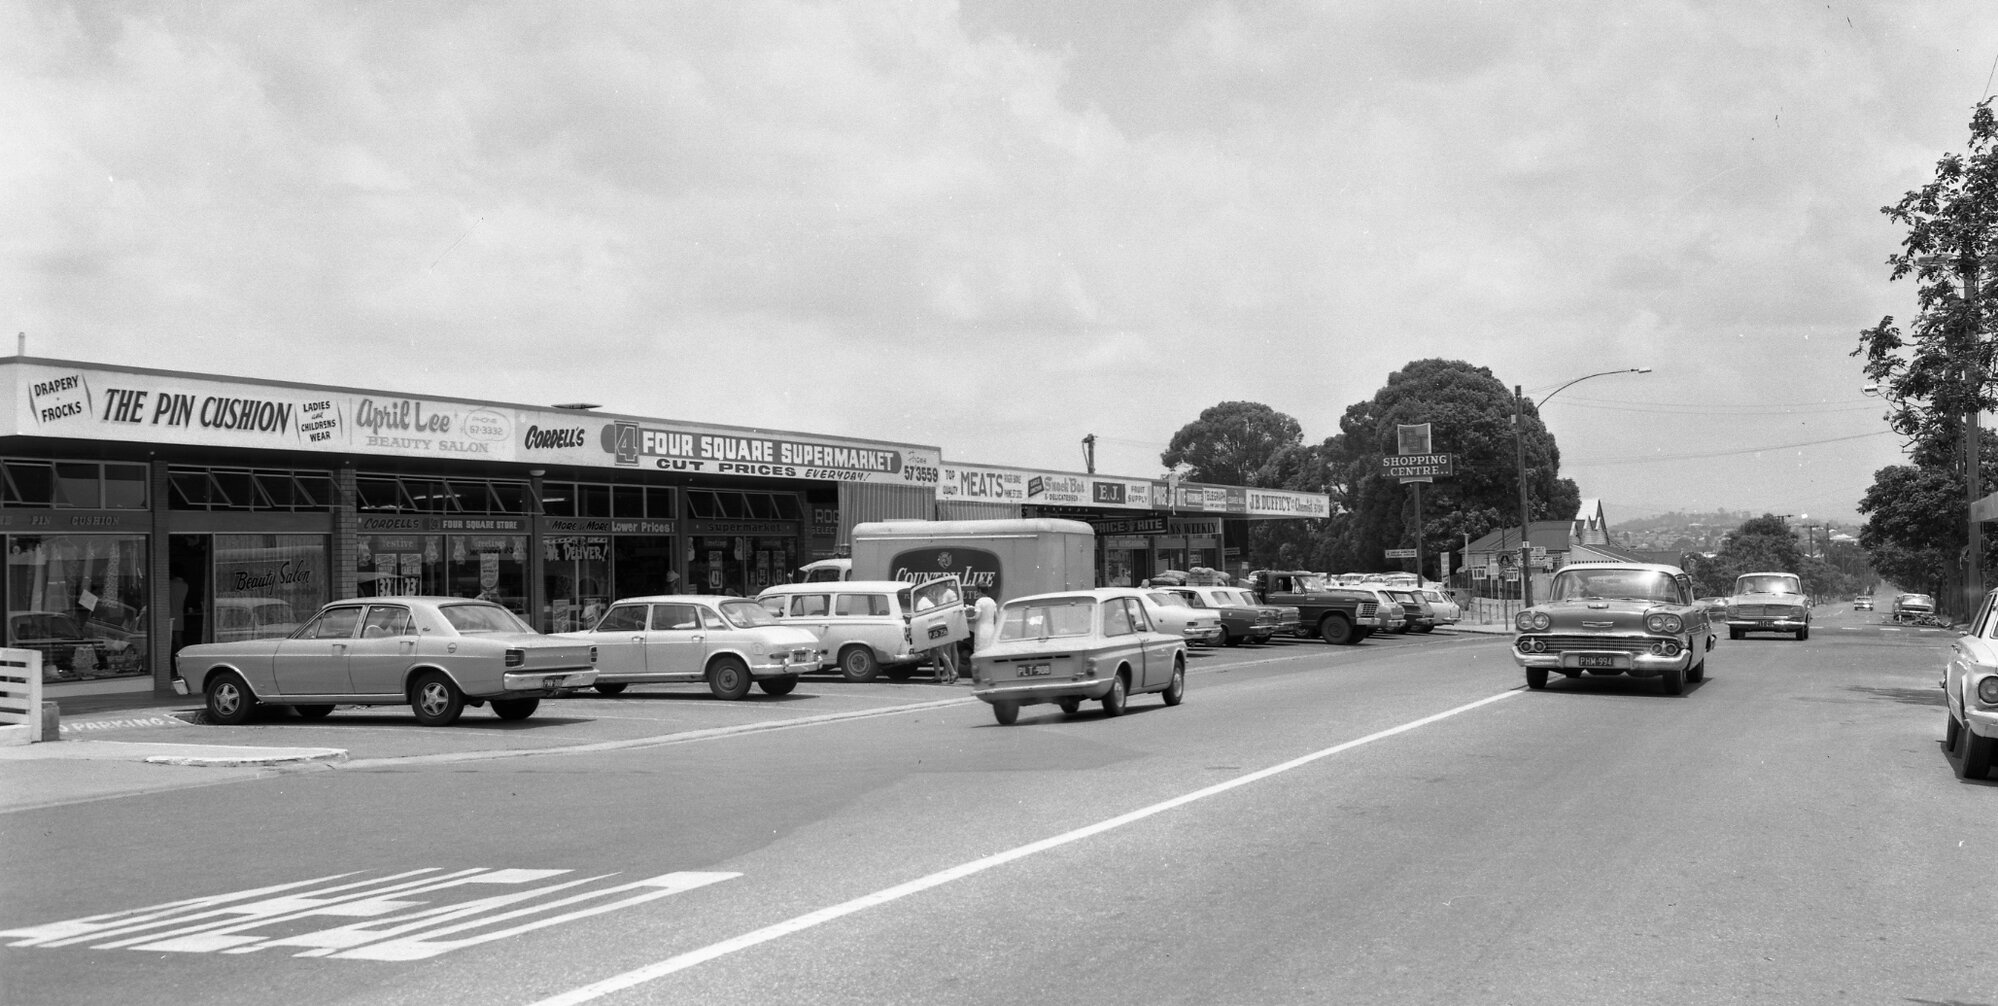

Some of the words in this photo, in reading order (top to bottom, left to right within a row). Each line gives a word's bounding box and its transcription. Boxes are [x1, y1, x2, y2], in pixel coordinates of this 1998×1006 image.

[34, 375, 79, 396] DRAPERY
[41, 401, 82, 423] FROCKS
[103, 388, 147, 424] THE
[152, 392, 195, 429] PIN
[200, 396, 292, 434] CUSHION
[303, 401, 330, 413] LADIES
[356, 398, 409, 435] April
[414, 402, 450, 433] Lee
[301, 418, 336, 432] CHILDRENS
[309, 431, 331, 443] WEAR
[366, 436, 431, 450] BEAUTY
[438, 439, 488, 453] SALON
[616, 425, 637, 462] 4
[643, 430, 693, 457] FOUR
[700, 436, 773, 463] SQUARE
[781, 443, 894, 471] SUPERMARKET
[656, 458, 704, 472] CUT
[718, 462, 796, 477] PRICES
[1383, 454, 1448, 467] SHOPPING
[945, 469, 955, 480] TOP
[960, 471, 1003, 498] MEATS
[1127, 494, 1148, 503] SUPPLY
[71, 516, 120, 526] CUSHION
[364, 518, 419, 529] CORDELLS
[443, 520, 463, 529] FOUR
[466, 520, 494, 530] SQUARE
[496, 520, 518, 529] STORE
[612, 521, 638, 532] Lower
[641, 521, 675, 533] Prices!
[1138, 518, 1163, 530] RITE
[234, 571, 277, 595] Beauty
[278, 560, 311, 585] Salon
[962, 566, 996, 587] LIFE
[1579, 656, 1613, 666] PHM-994
